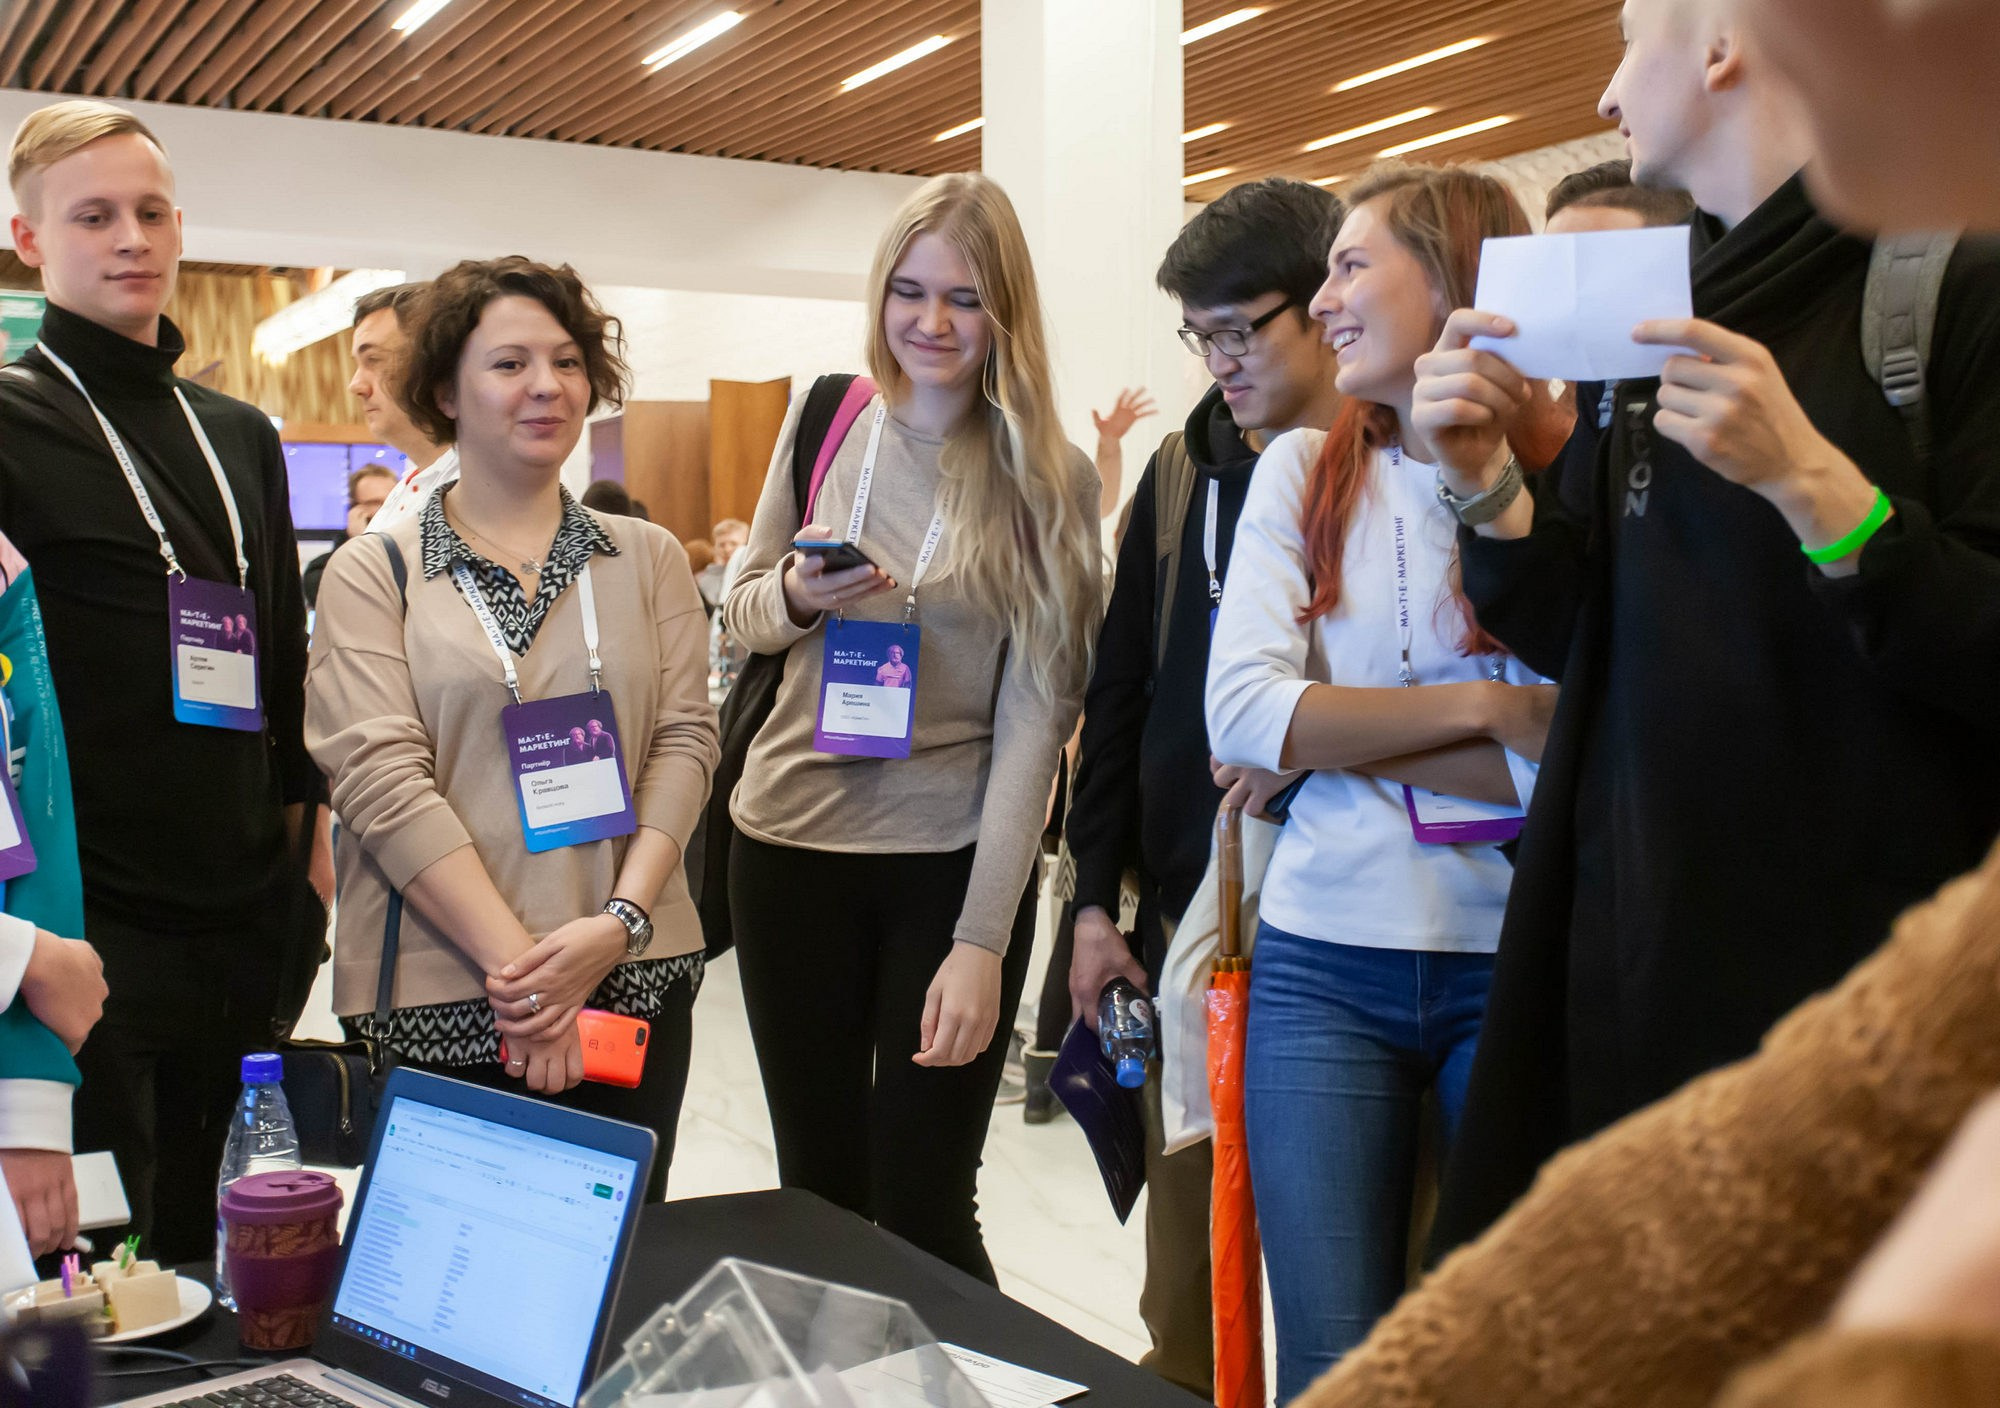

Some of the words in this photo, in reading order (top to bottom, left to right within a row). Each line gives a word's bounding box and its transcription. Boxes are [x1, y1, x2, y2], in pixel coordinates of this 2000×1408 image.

[1394, 515, 1407, 578] МАРКЕТИНГ
[833, 658, 878, 668] МАРКЕТИНГ
[519, 737, 571, 753] МАРКЕТИНГ
